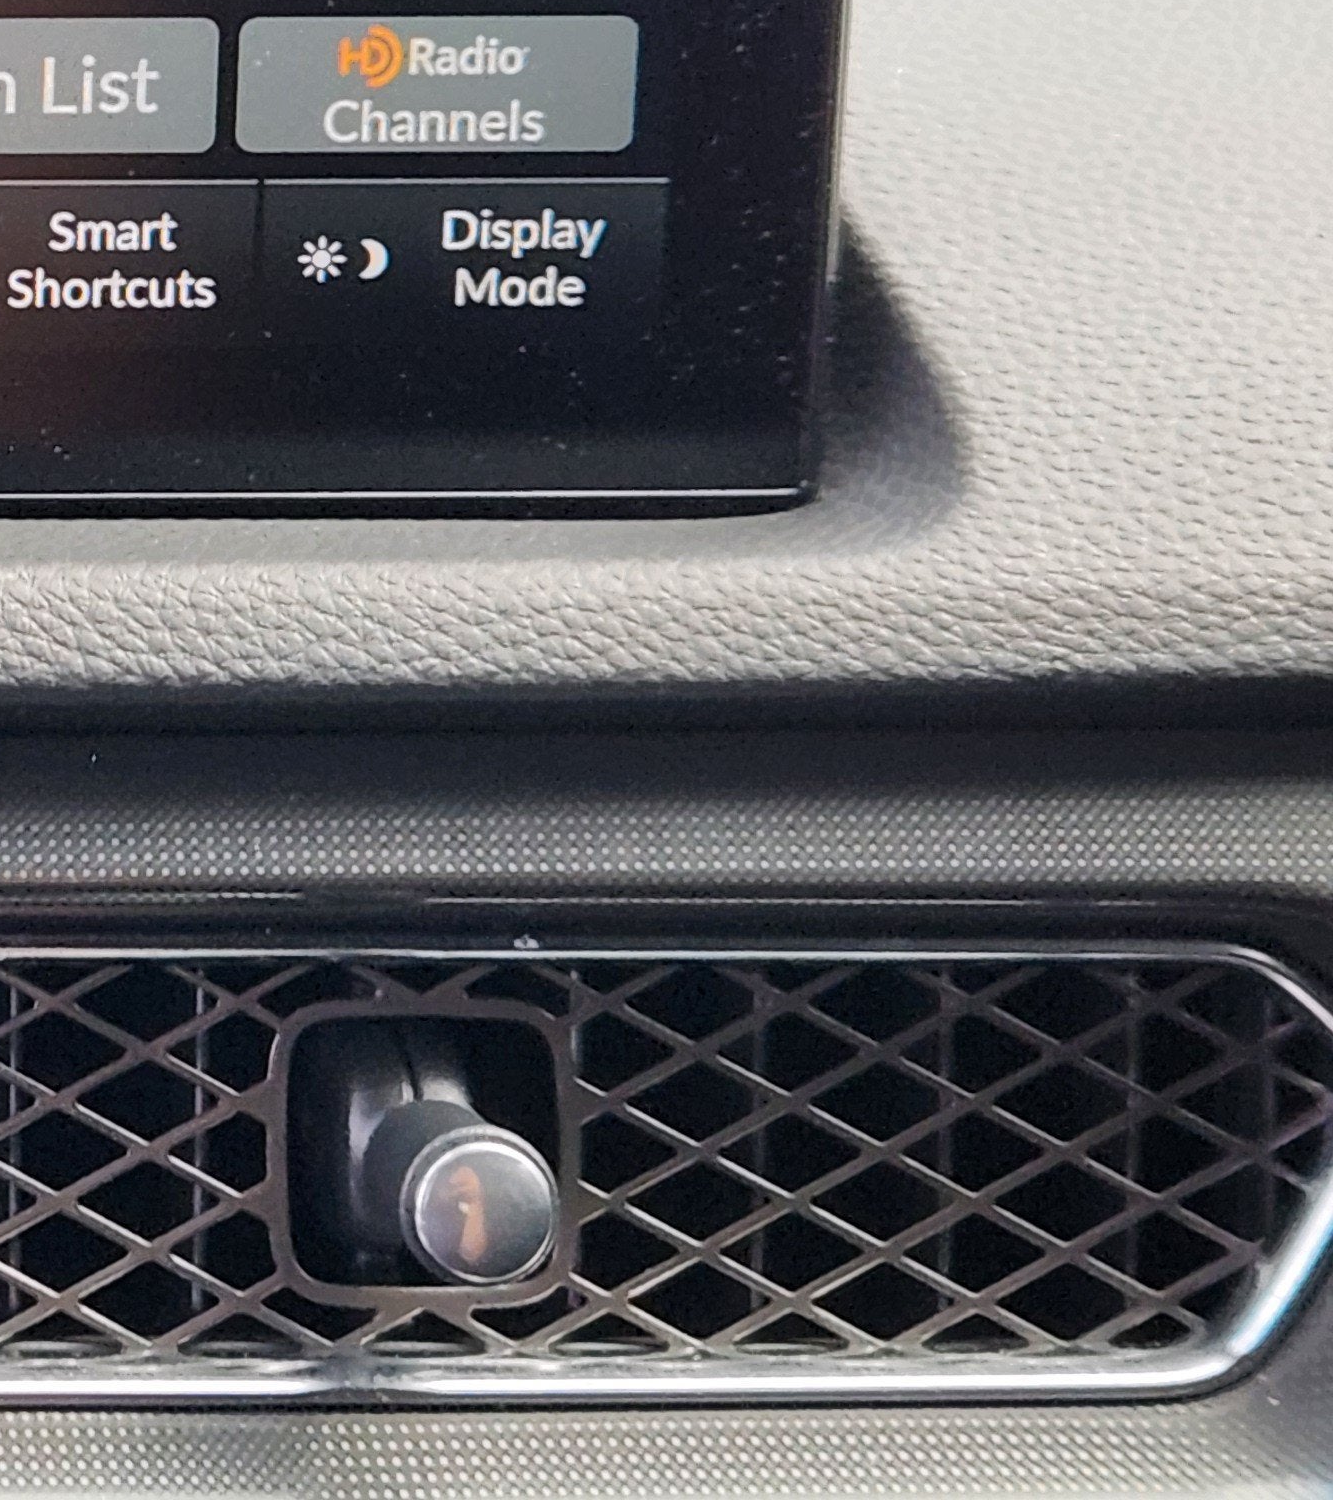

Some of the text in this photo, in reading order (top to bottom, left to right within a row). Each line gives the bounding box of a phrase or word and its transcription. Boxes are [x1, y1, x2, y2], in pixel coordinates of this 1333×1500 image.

[407, 32, 529, 80] Radio
[42, 54, 160, 115] List
[323, 98, 544, 143] Channels
[48, 211, 178, 252] Smart
[441, 208, 606, 259] Display
[7, 266, 217, 309] Shortcuts
[454, 265, 586, 307] Mode
